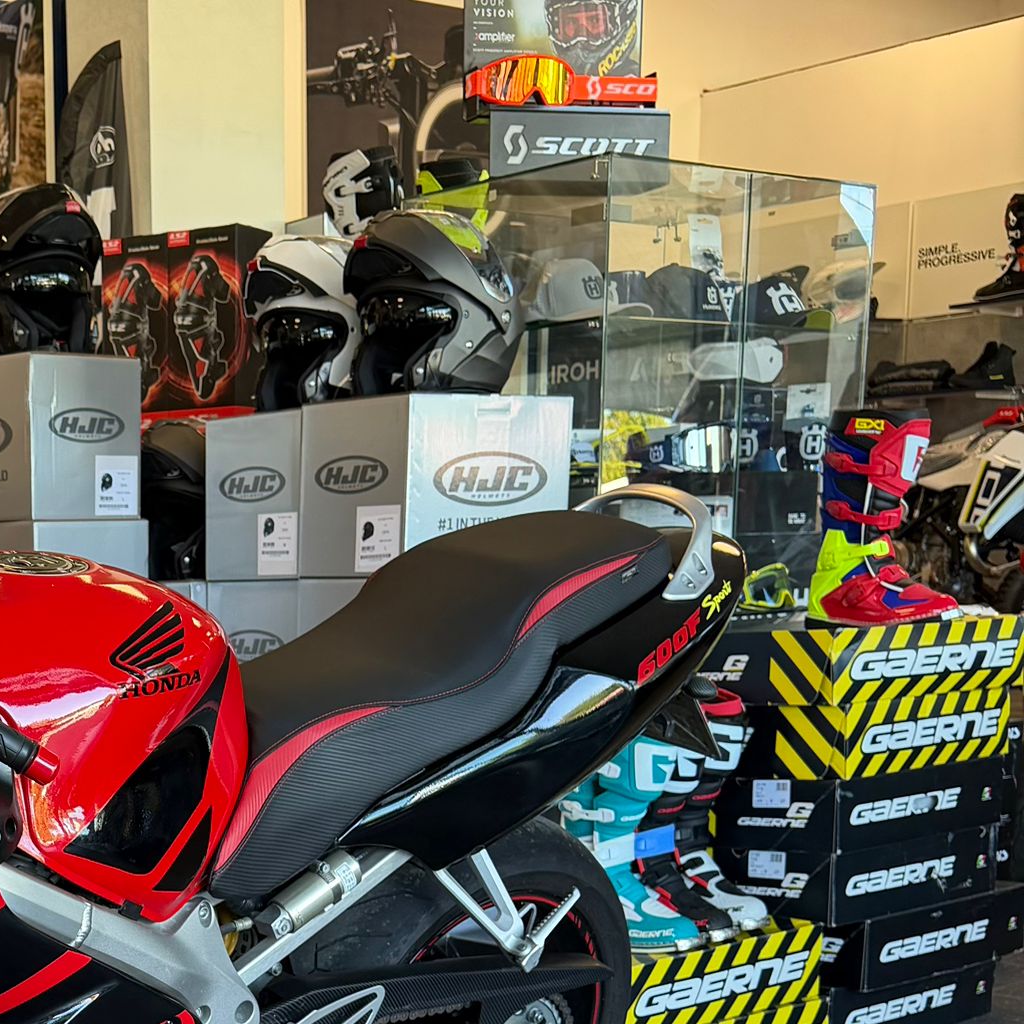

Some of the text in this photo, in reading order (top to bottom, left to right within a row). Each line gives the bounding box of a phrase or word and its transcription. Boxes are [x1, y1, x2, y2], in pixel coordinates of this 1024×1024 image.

[473, 7, 514, 18] VISION
[531, 136, 657, 156] SCOTT
[917, 248, 996, 271] PROGRESSIVE
[550, 358, 600, 386] IROH
[59, 416, 116, 435] HJC
[228, 473, 276, 495] HJC
[324, 463, 379, 486] HJC
[448, 465, 536, 493] HJC
[637, 579, 732, 686] 600F Sport
[118, 669, 202, 699] HONDA
